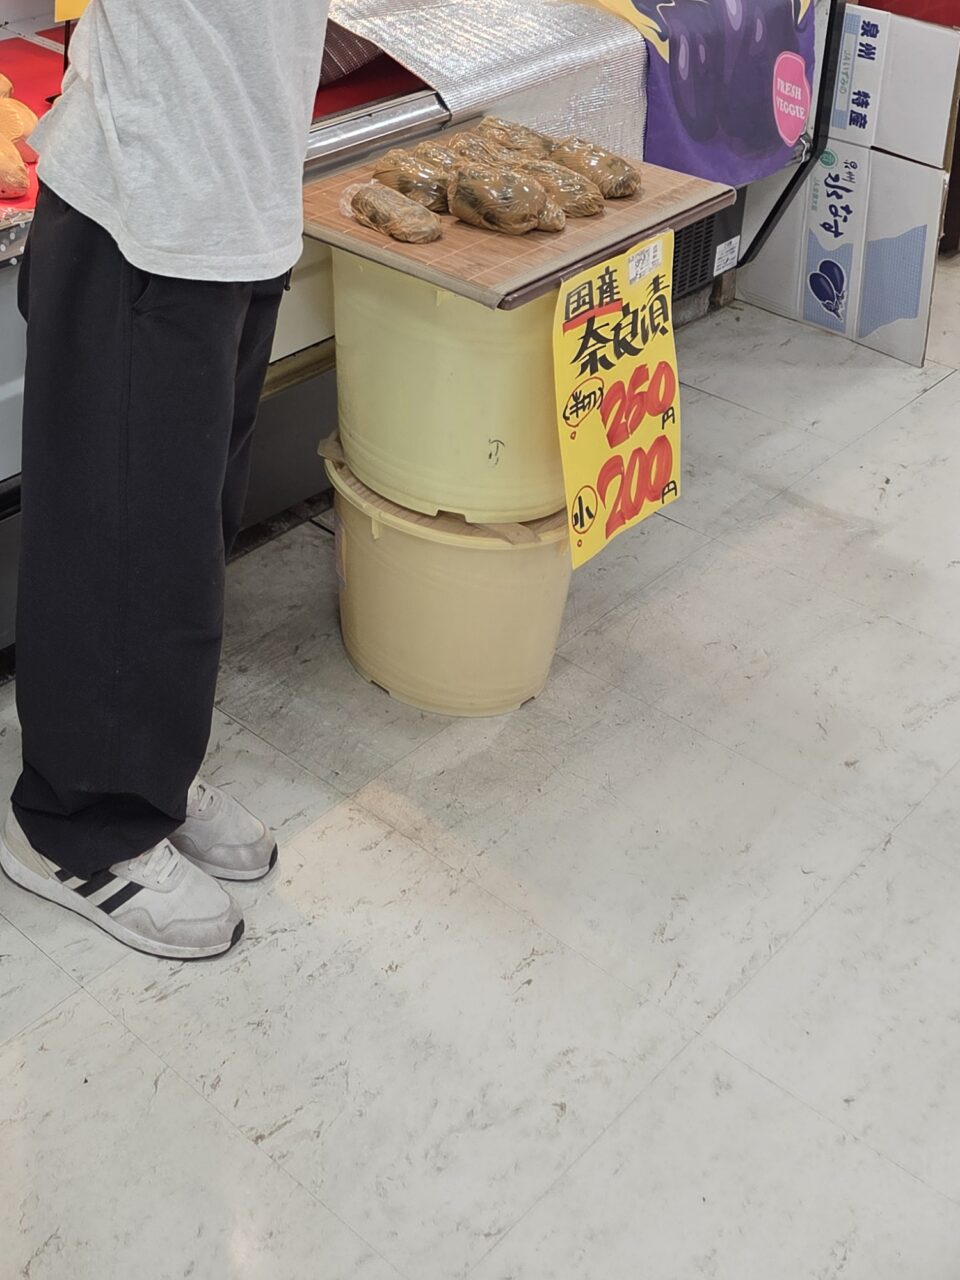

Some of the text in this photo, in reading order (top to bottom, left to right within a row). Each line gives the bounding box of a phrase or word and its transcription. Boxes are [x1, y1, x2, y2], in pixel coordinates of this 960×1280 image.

[776, 78, 802, 101] FRESH
[849, 20, 880, 129] 泉州 特産
[775, 97, 807, 121] VEGGIE
[819, 172, 853, 238] 水なす
[564, 266, 623, 320] 国産
[570, 273, 671, 379] 奈良漬
